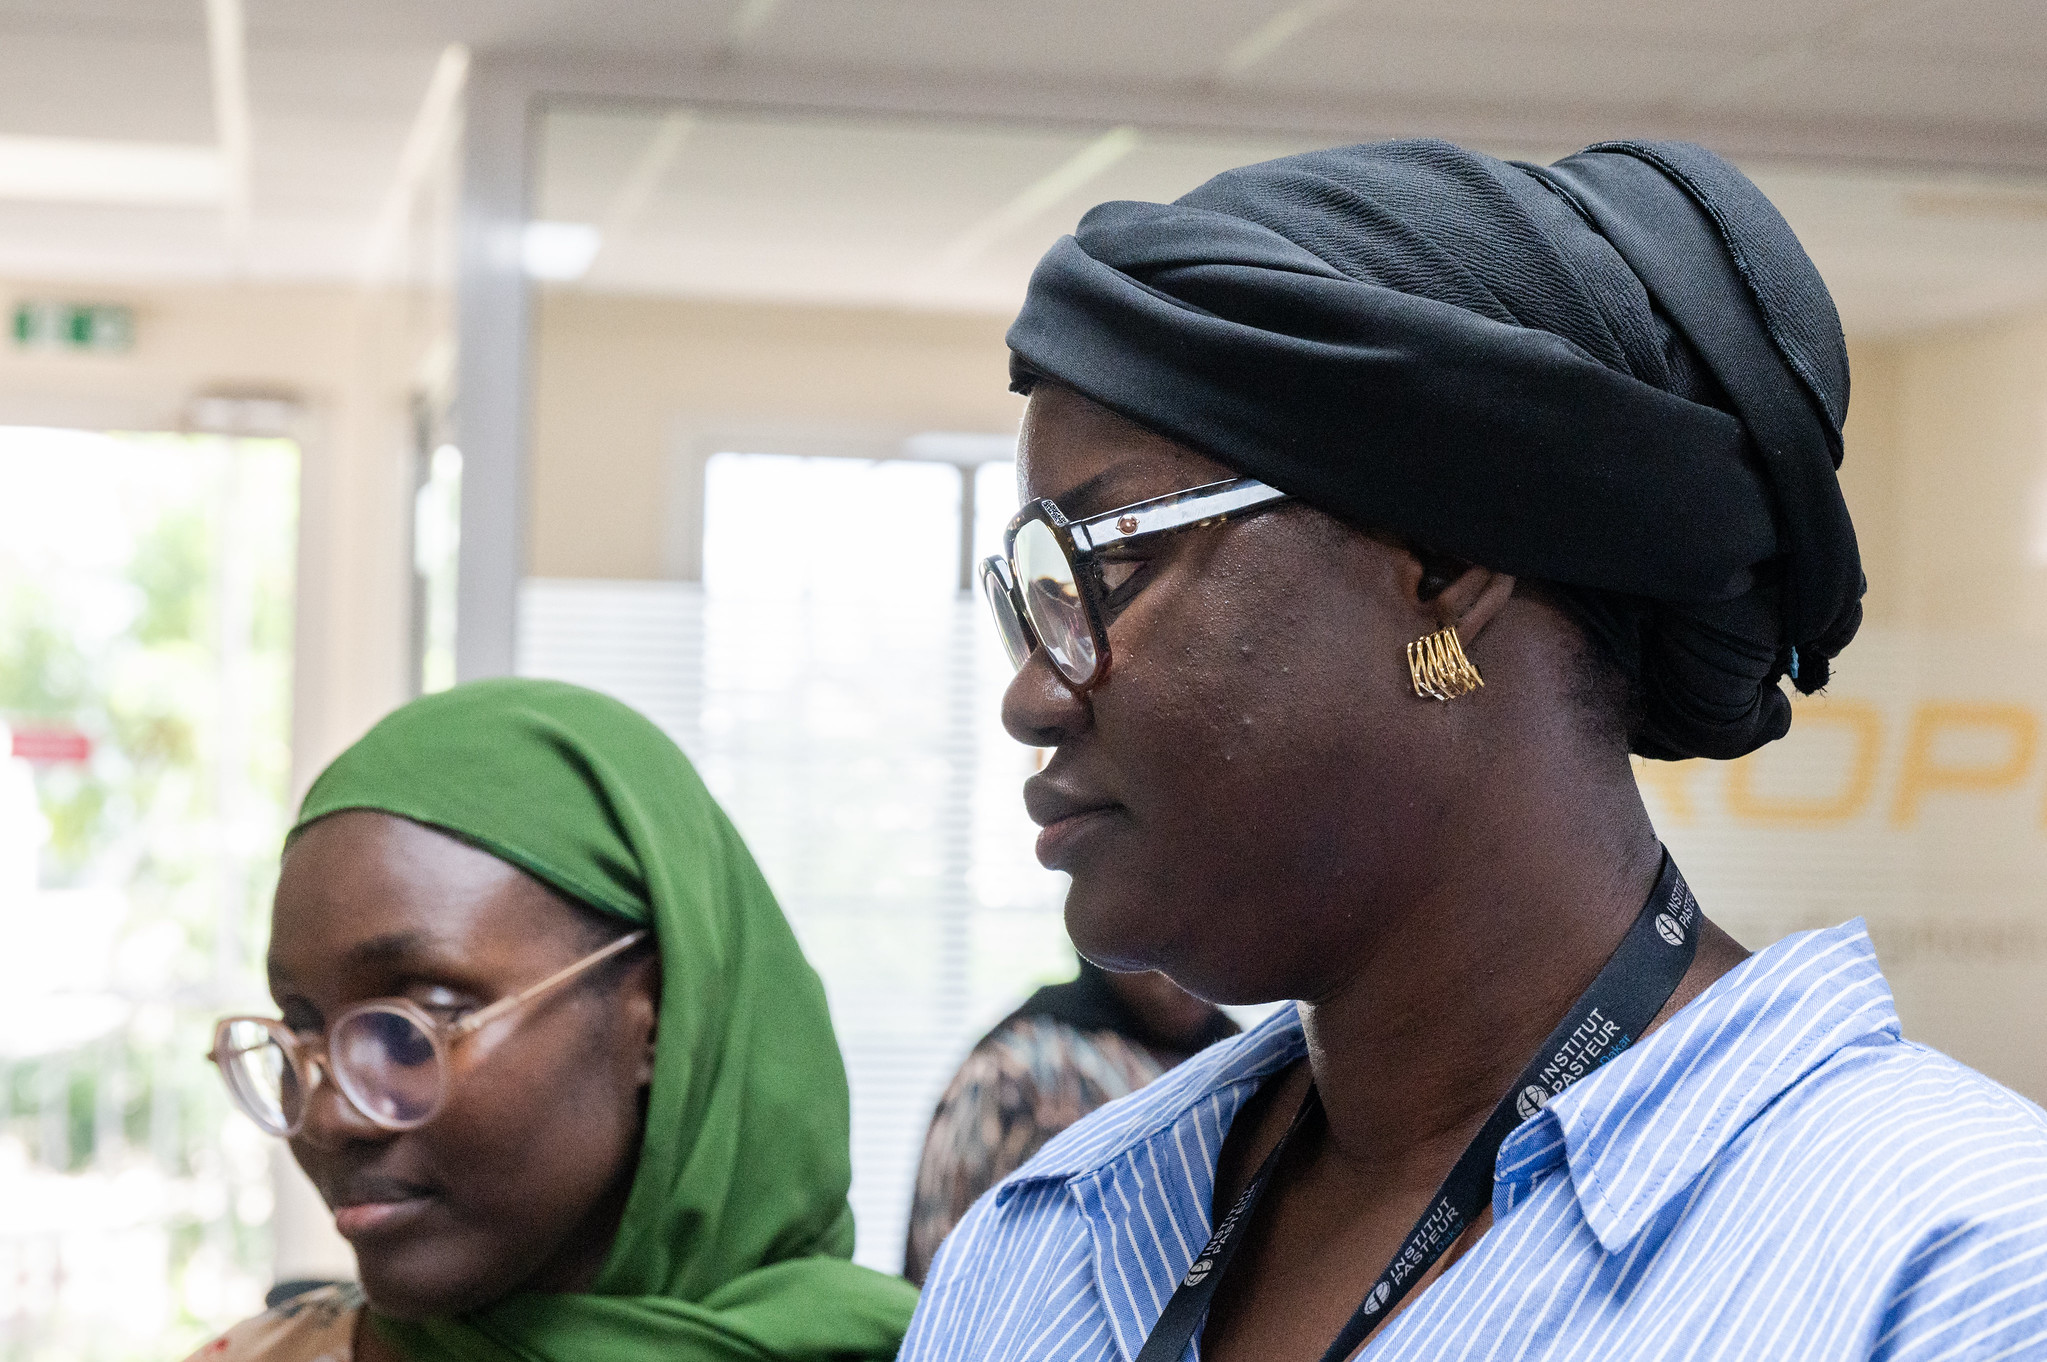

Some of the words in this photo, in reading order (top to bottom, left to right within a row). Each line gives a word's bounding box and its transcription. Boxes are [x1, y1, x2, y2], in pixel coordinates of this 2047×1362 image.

[1540, 1007, 1604, 1084] INSTITUT
[1551, 1020, 1620, 1094] PASTEUR
[1600, 1034, 1631, 1065] Dakar
[1202, 1189, 1250, 1256] INSTITUT
[1390, 1196, 1449, 1278] INSTITUT
[1394, 1207, 1459, 1286] PASTEUR
[1436, 1218, 1464, 1253] Dakar
